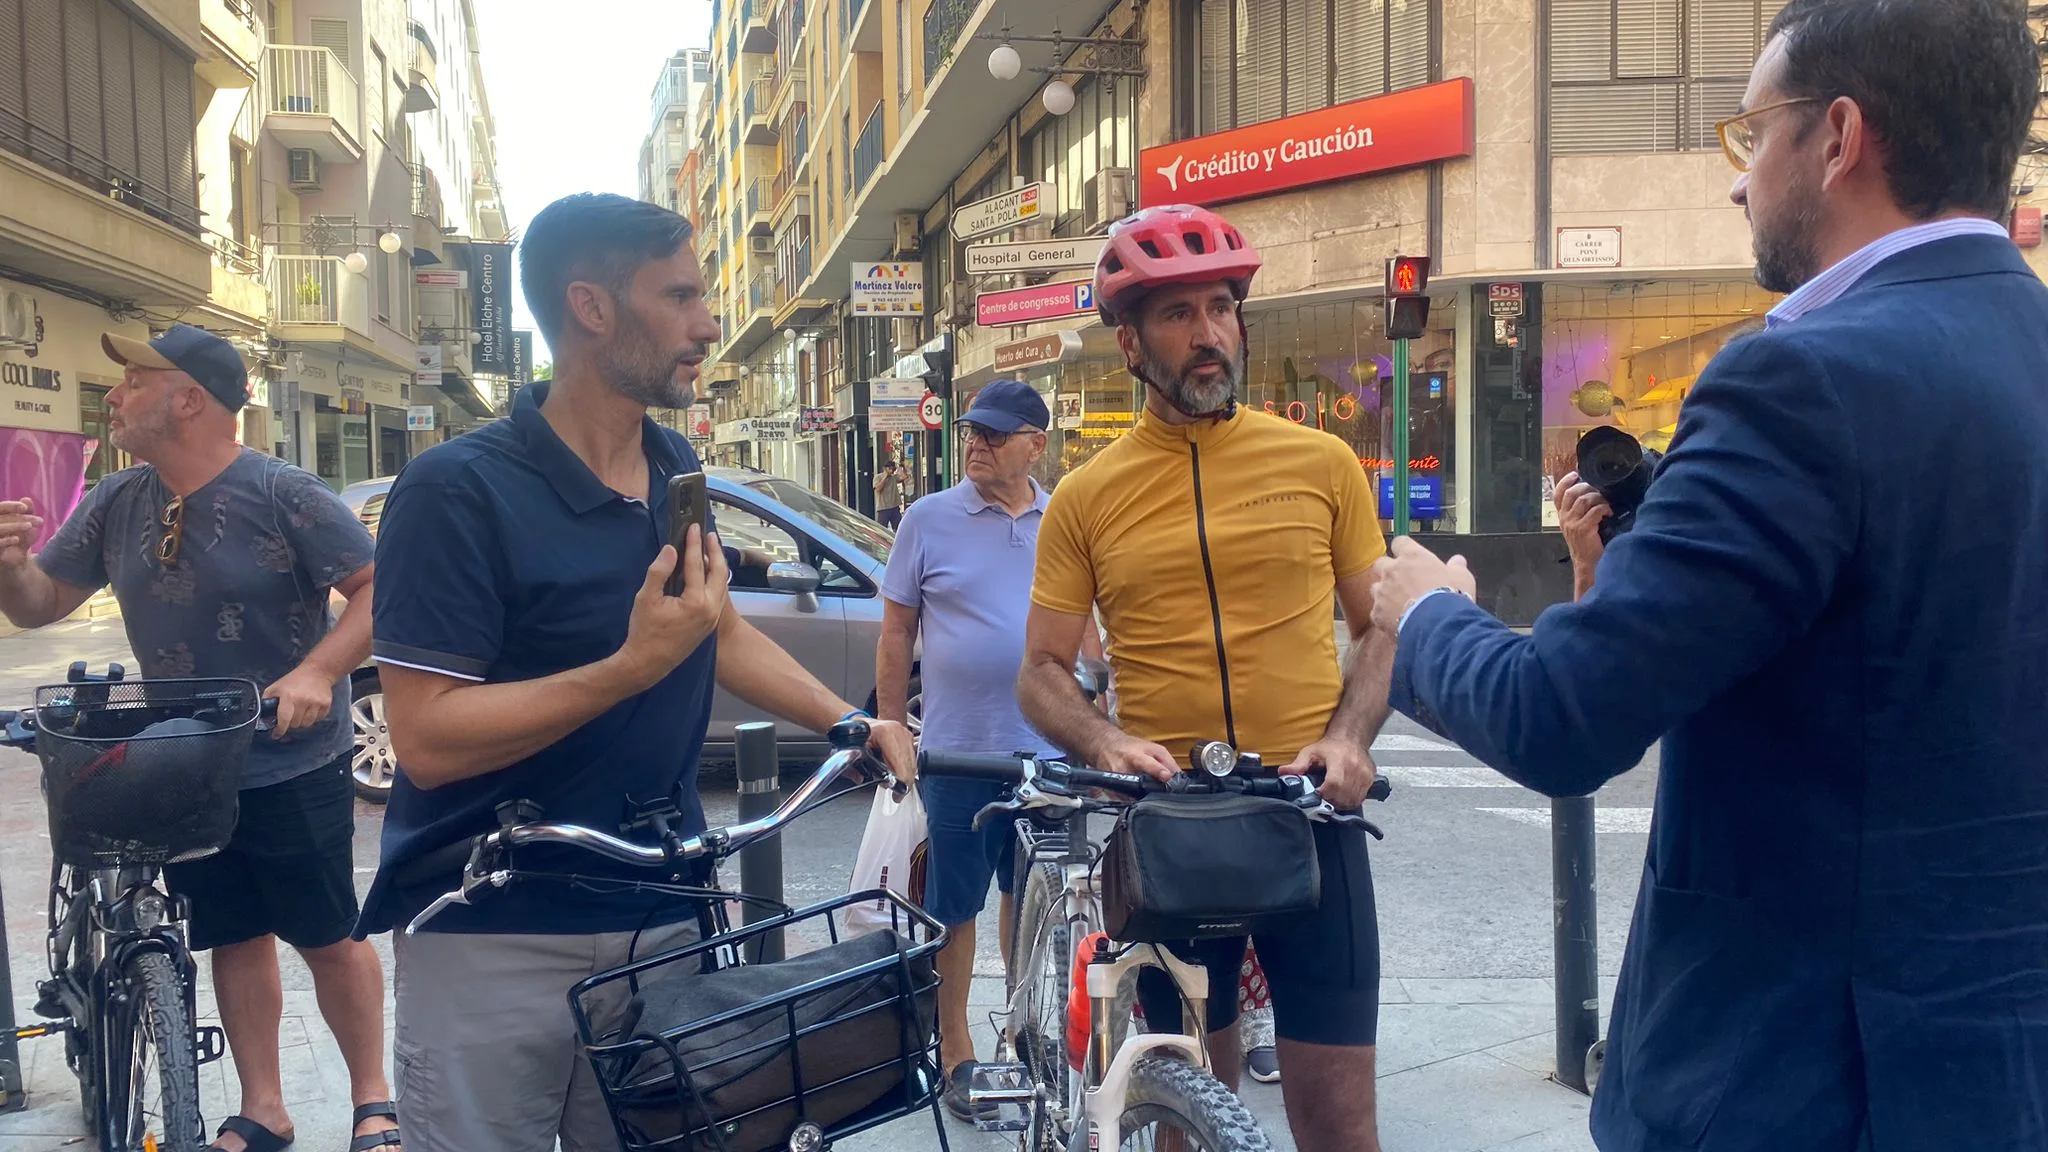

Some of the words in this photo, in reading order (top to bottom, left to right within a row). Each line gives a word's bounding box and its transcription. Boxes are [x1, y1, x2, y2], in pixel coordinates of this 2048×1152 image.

[1184, 150, 1259, 183] Crédito
[1260, 147, 1277, 172] y
[1280, 125, 1373, 163] Caución
[984, 194, 1019, 215] ALACANT
[971, 216, 995, 232] SANTA
[997, 208, 1018, 223] POLA
[973, 252, 1021, 266] Hospital
[1028, 248, 1075, 261] General
[482, 254, 493, 294] Centro
[854, 280, 892, 290] Martínez
[895, 280, 922, 290] Valero
[1491, 286, 1520, 298] SDS
[980, 302, 1007, 315] Centre
[1008, 300, 1019, 311] de
[1020, 294, 1071, 312] congressos
[1077, 285, 1090, 309] P
[482, 296, 493, 329] Elche
[482, 331, 493, 362] Hotel
[513, 338, 521, 363] Centro
[1015, 348, 1024, 359] del
[1025, 347, 1039, 357] Cura
[925, 404, 942, 417] 30
[751, 419, 790, 431] Gásquez
[757, 430, 786, 438] Bravo
